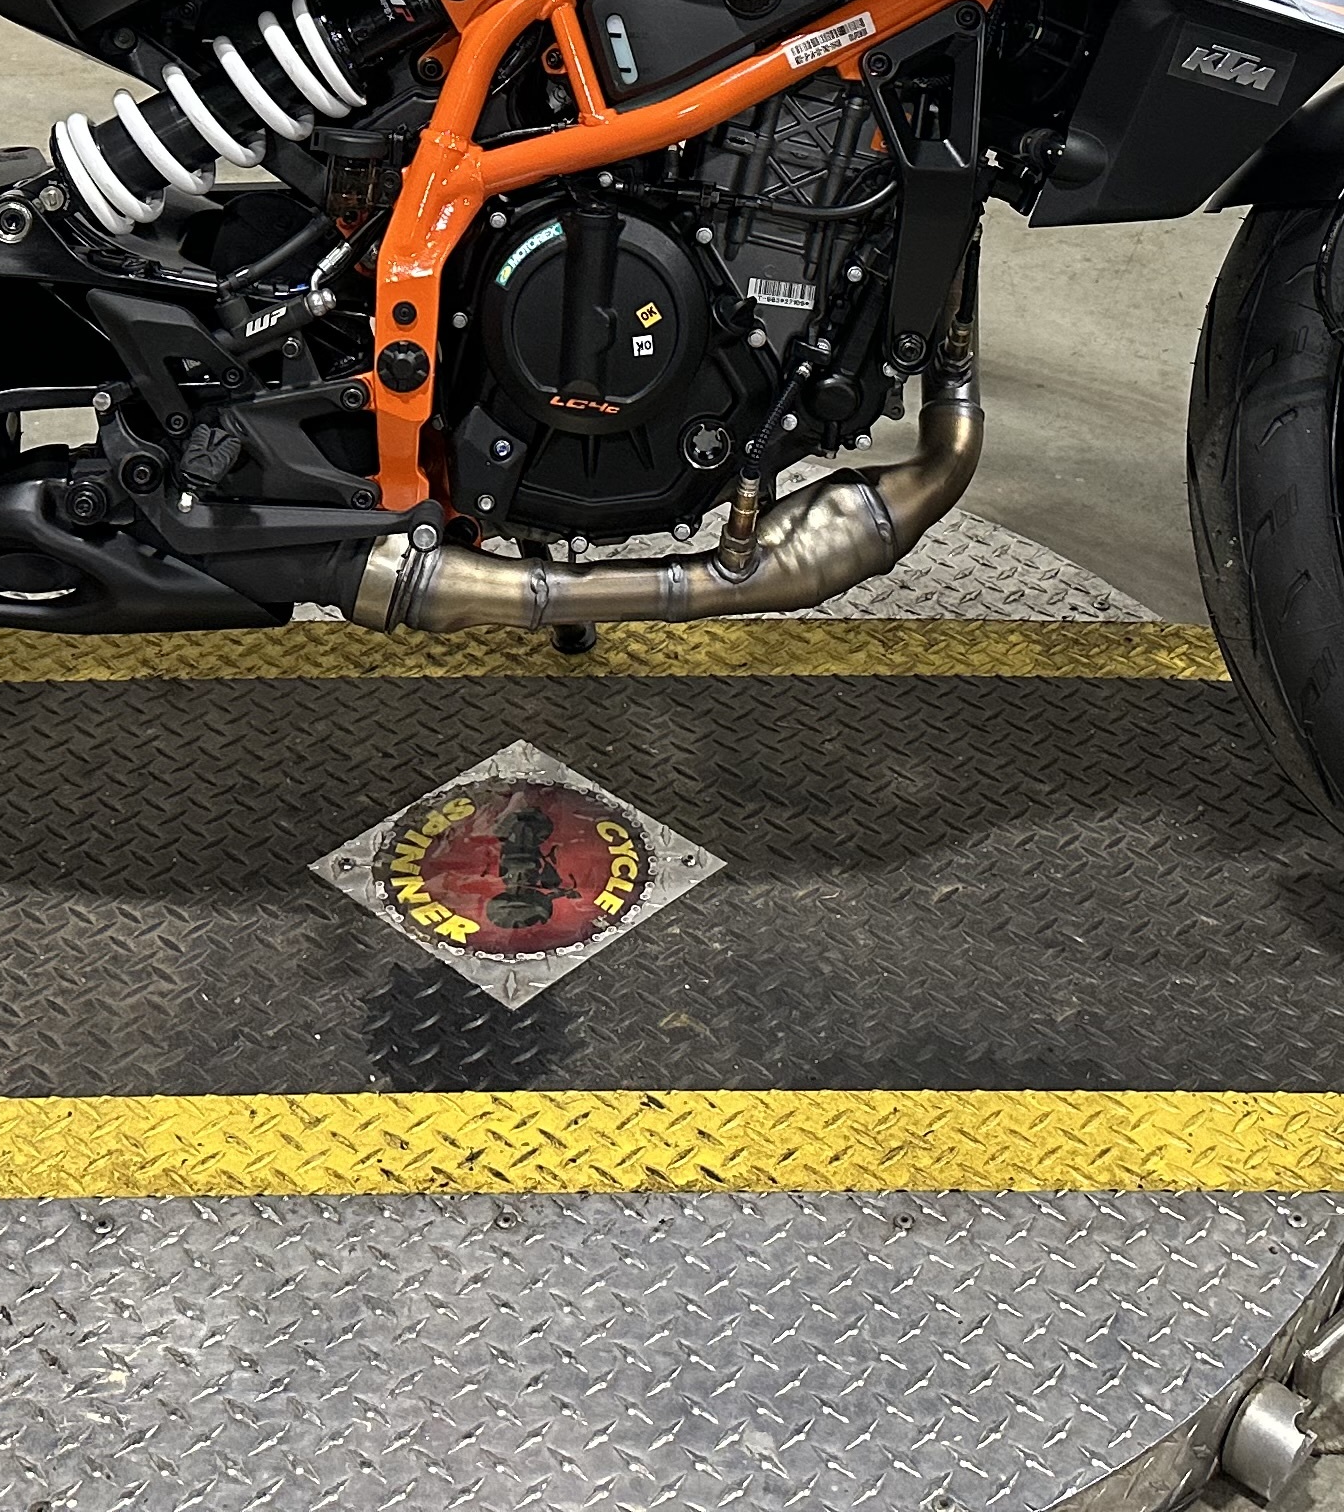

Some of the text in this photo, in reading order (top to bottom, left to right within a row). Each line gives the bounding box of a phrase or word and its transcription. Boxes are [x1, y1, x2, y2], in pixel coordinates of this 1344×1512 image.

[1181, 44, 1276, 91] KTM
[508, 224, 561, 269] MOTOREX
[245, 306, 288, 337] WP
[640, 305, 657, 321] OK
[635, 339, 652, 355] OK
[389, 797, 481, 944] SPINNER
[595, 819, 640, 916] CYCLE
